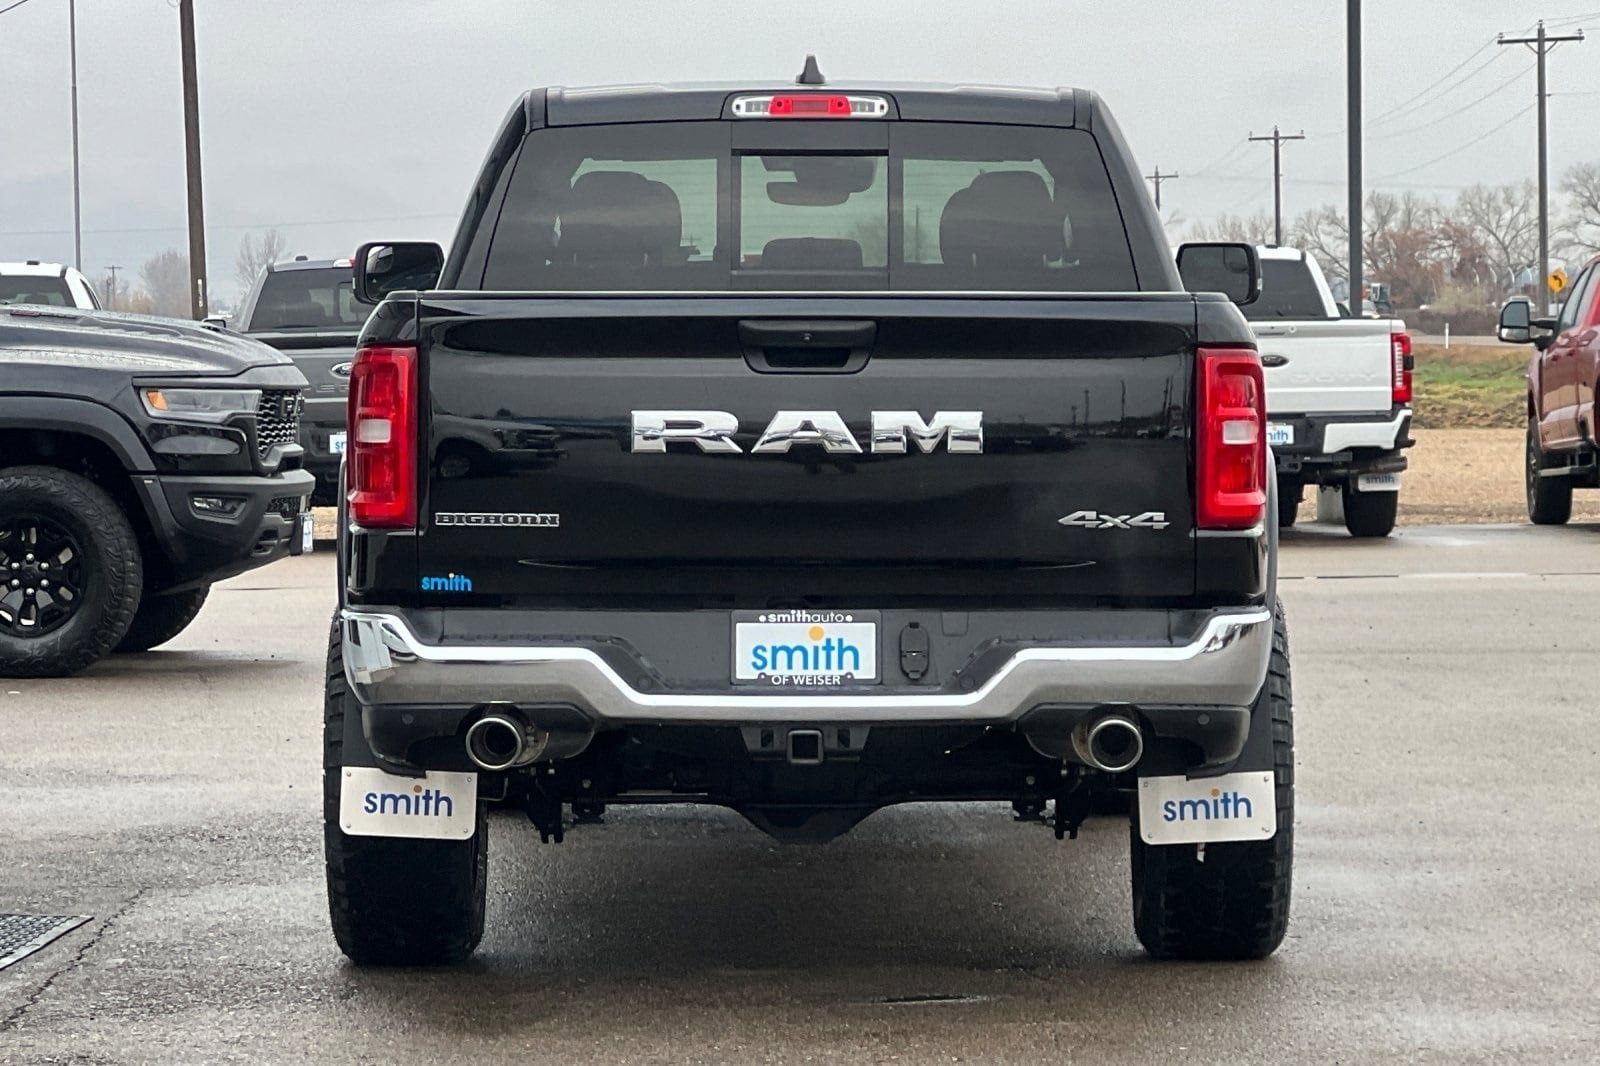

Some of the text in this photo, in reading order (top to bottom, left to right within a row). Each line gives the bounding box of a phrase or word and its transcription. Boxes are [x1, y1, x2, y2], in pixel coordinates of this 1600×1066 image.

[631, 410, 983, 454] RAM
[1266, 427, 1289, 441] ith
[1366, 474, 1395, 485] smith
[435, 512, 560, 527] BIGHORN
[1058, 510, 1170, 530] 4x4
[421, 572, 473, 592] smith
[767, 609, 844, 623] smithauto
[751, 625, 860, 671] smith
[771, 674, 841, 686] OF WEISER
[364, 784, 453, 817] smith
[1163, 788, 1252, 822] smith
